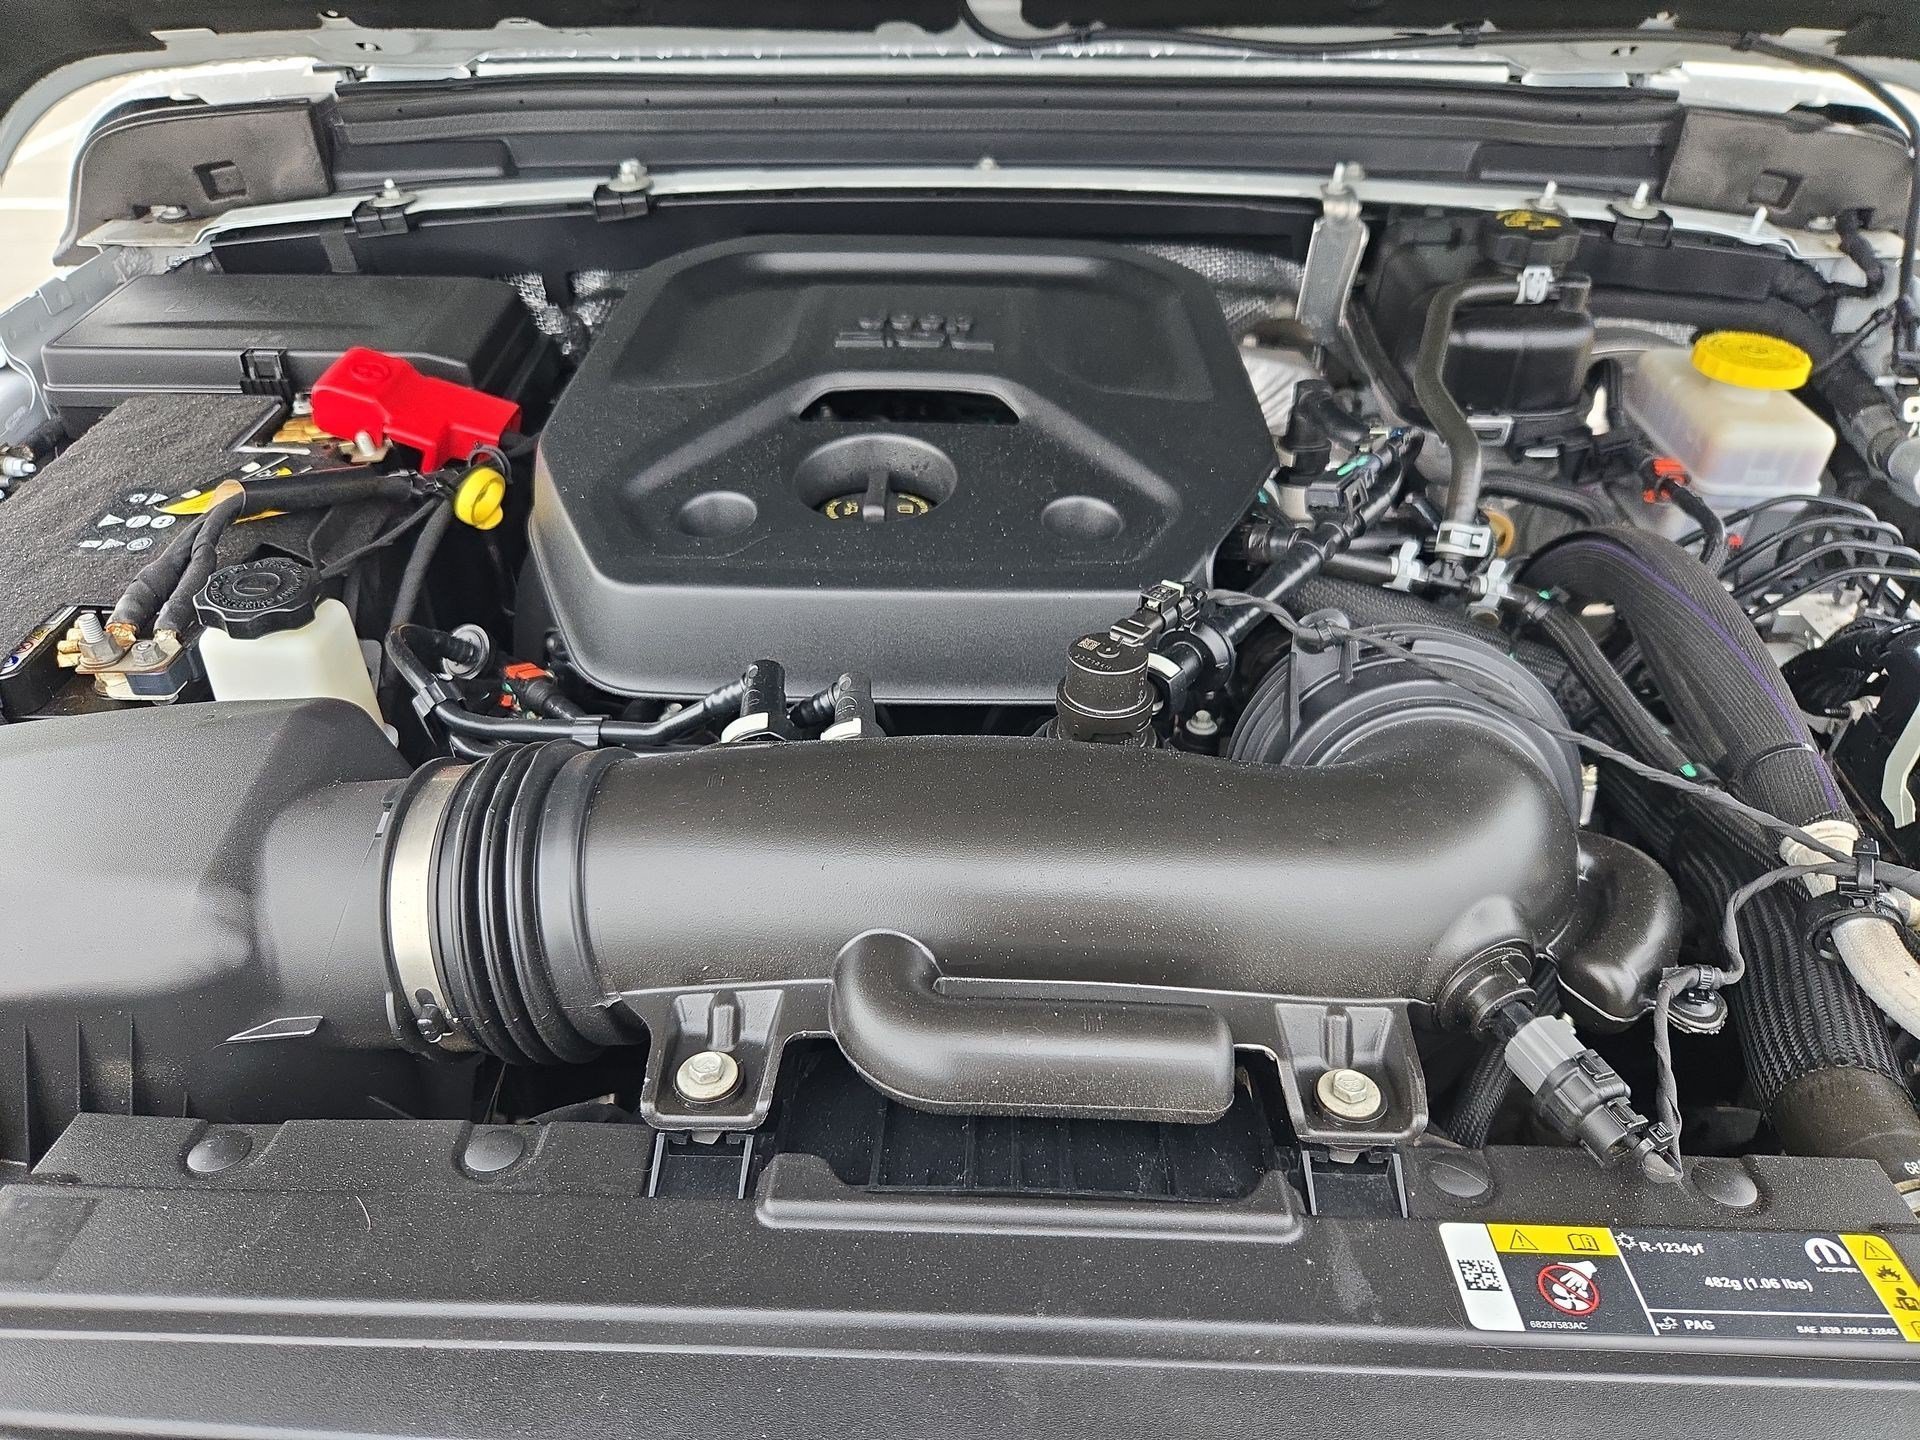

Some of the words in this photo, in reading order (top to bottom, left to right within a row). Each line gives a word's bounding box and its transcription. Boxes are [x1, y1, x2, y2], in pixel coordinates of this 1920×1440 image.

[1638, 1241, 1705, 1257] R-1234yf
[1704, 1276, 1742, 1291] 482g
[1743, 1277, 1782, 1291] (1.06
[1783, 1278, 1814, 1293] lbs)
[1683, 1319, 1716, 1331] PAG
[1796, 1325, 1818, 1334] SAE
